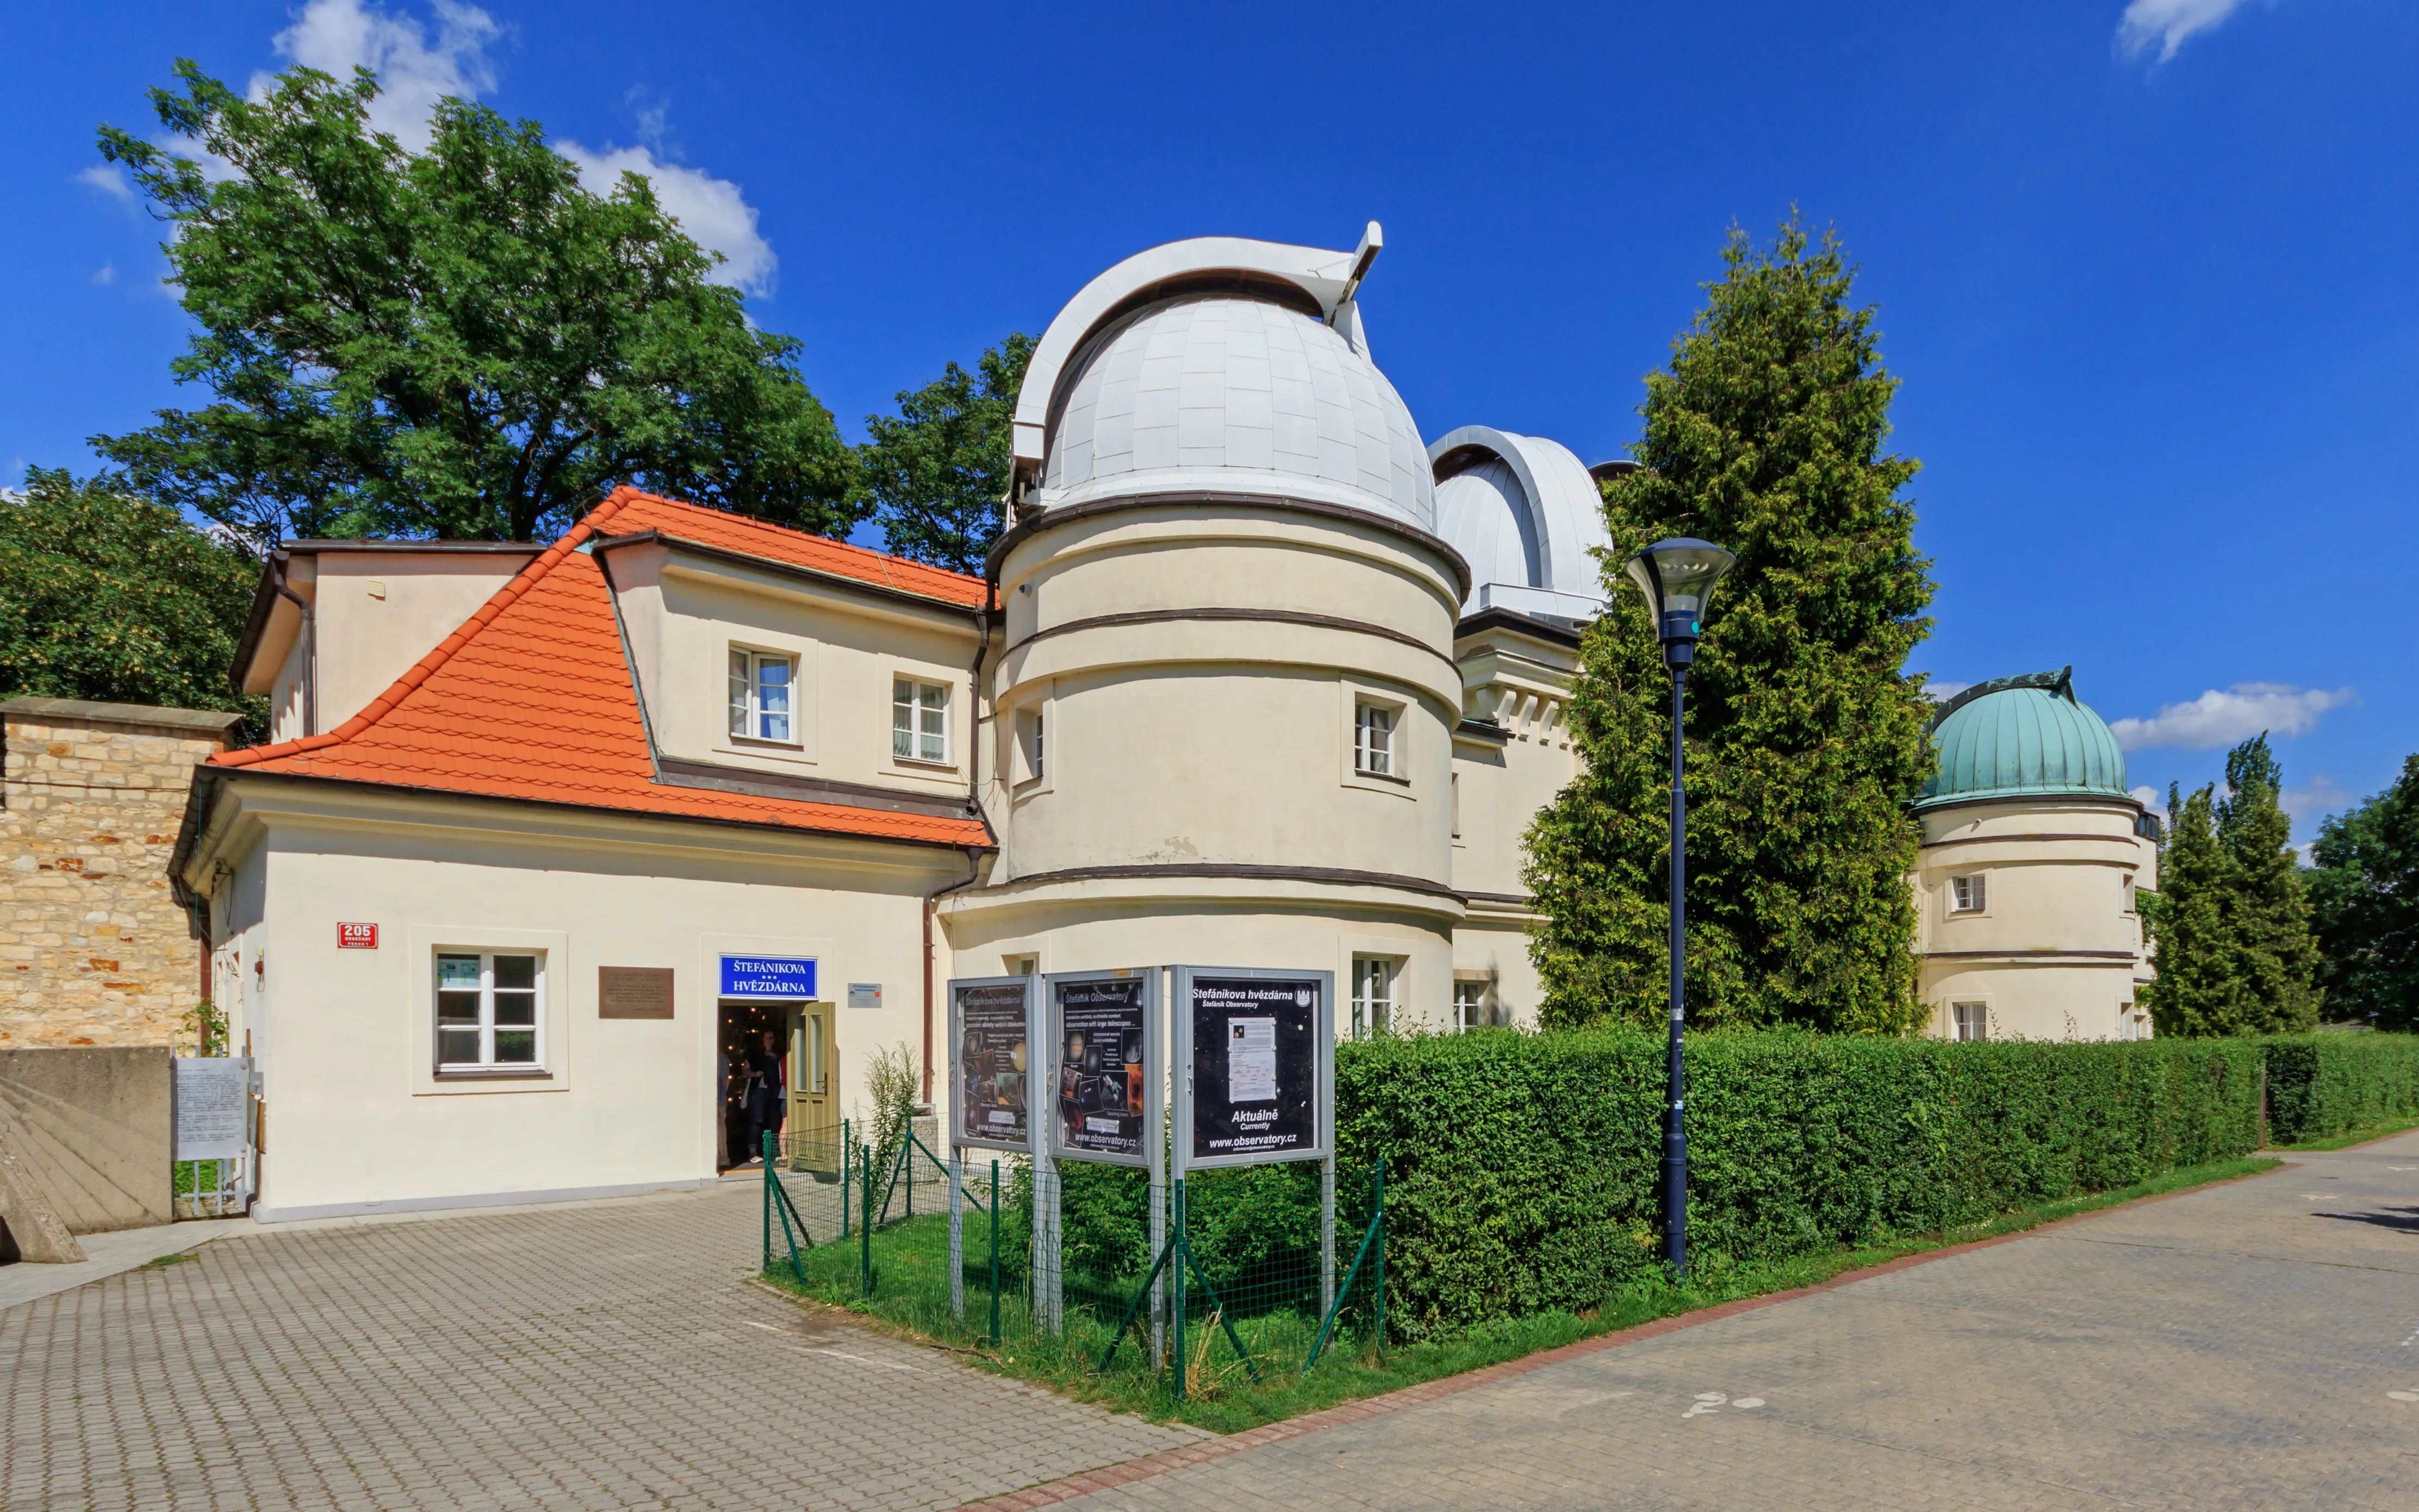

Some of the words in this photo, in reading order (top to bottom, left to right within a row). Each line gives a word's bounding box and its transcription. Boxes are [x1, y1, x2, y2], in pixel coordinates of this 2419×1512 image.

[344, 925, 371, 936] 205
[733, 960, 806, 974] ŠTEFÁNIKOVA
[733, 980, 806, 992] HVĚZDÁRNA
[1091, 993, 1129, 1003] Observatory
[1192, 986, 1246, 999] Štefánikova
[1248, 990, 1293, 1000] hvězdárna
[1202, 999, 1225, 1007] Štefánik
[1226, 1001, 1259, 1009] Observatory
[1232, 1109, 1278, 1123] Aktuálně
[977, 1124, 1026, 1136] www.observatory.cz
[1240, 1122, 1271, 1130] Currently
[1075, 1134, 1136, 1148] www.observatory.cz
[1210, 1134, 1297, 1148] www.observatory.cz
